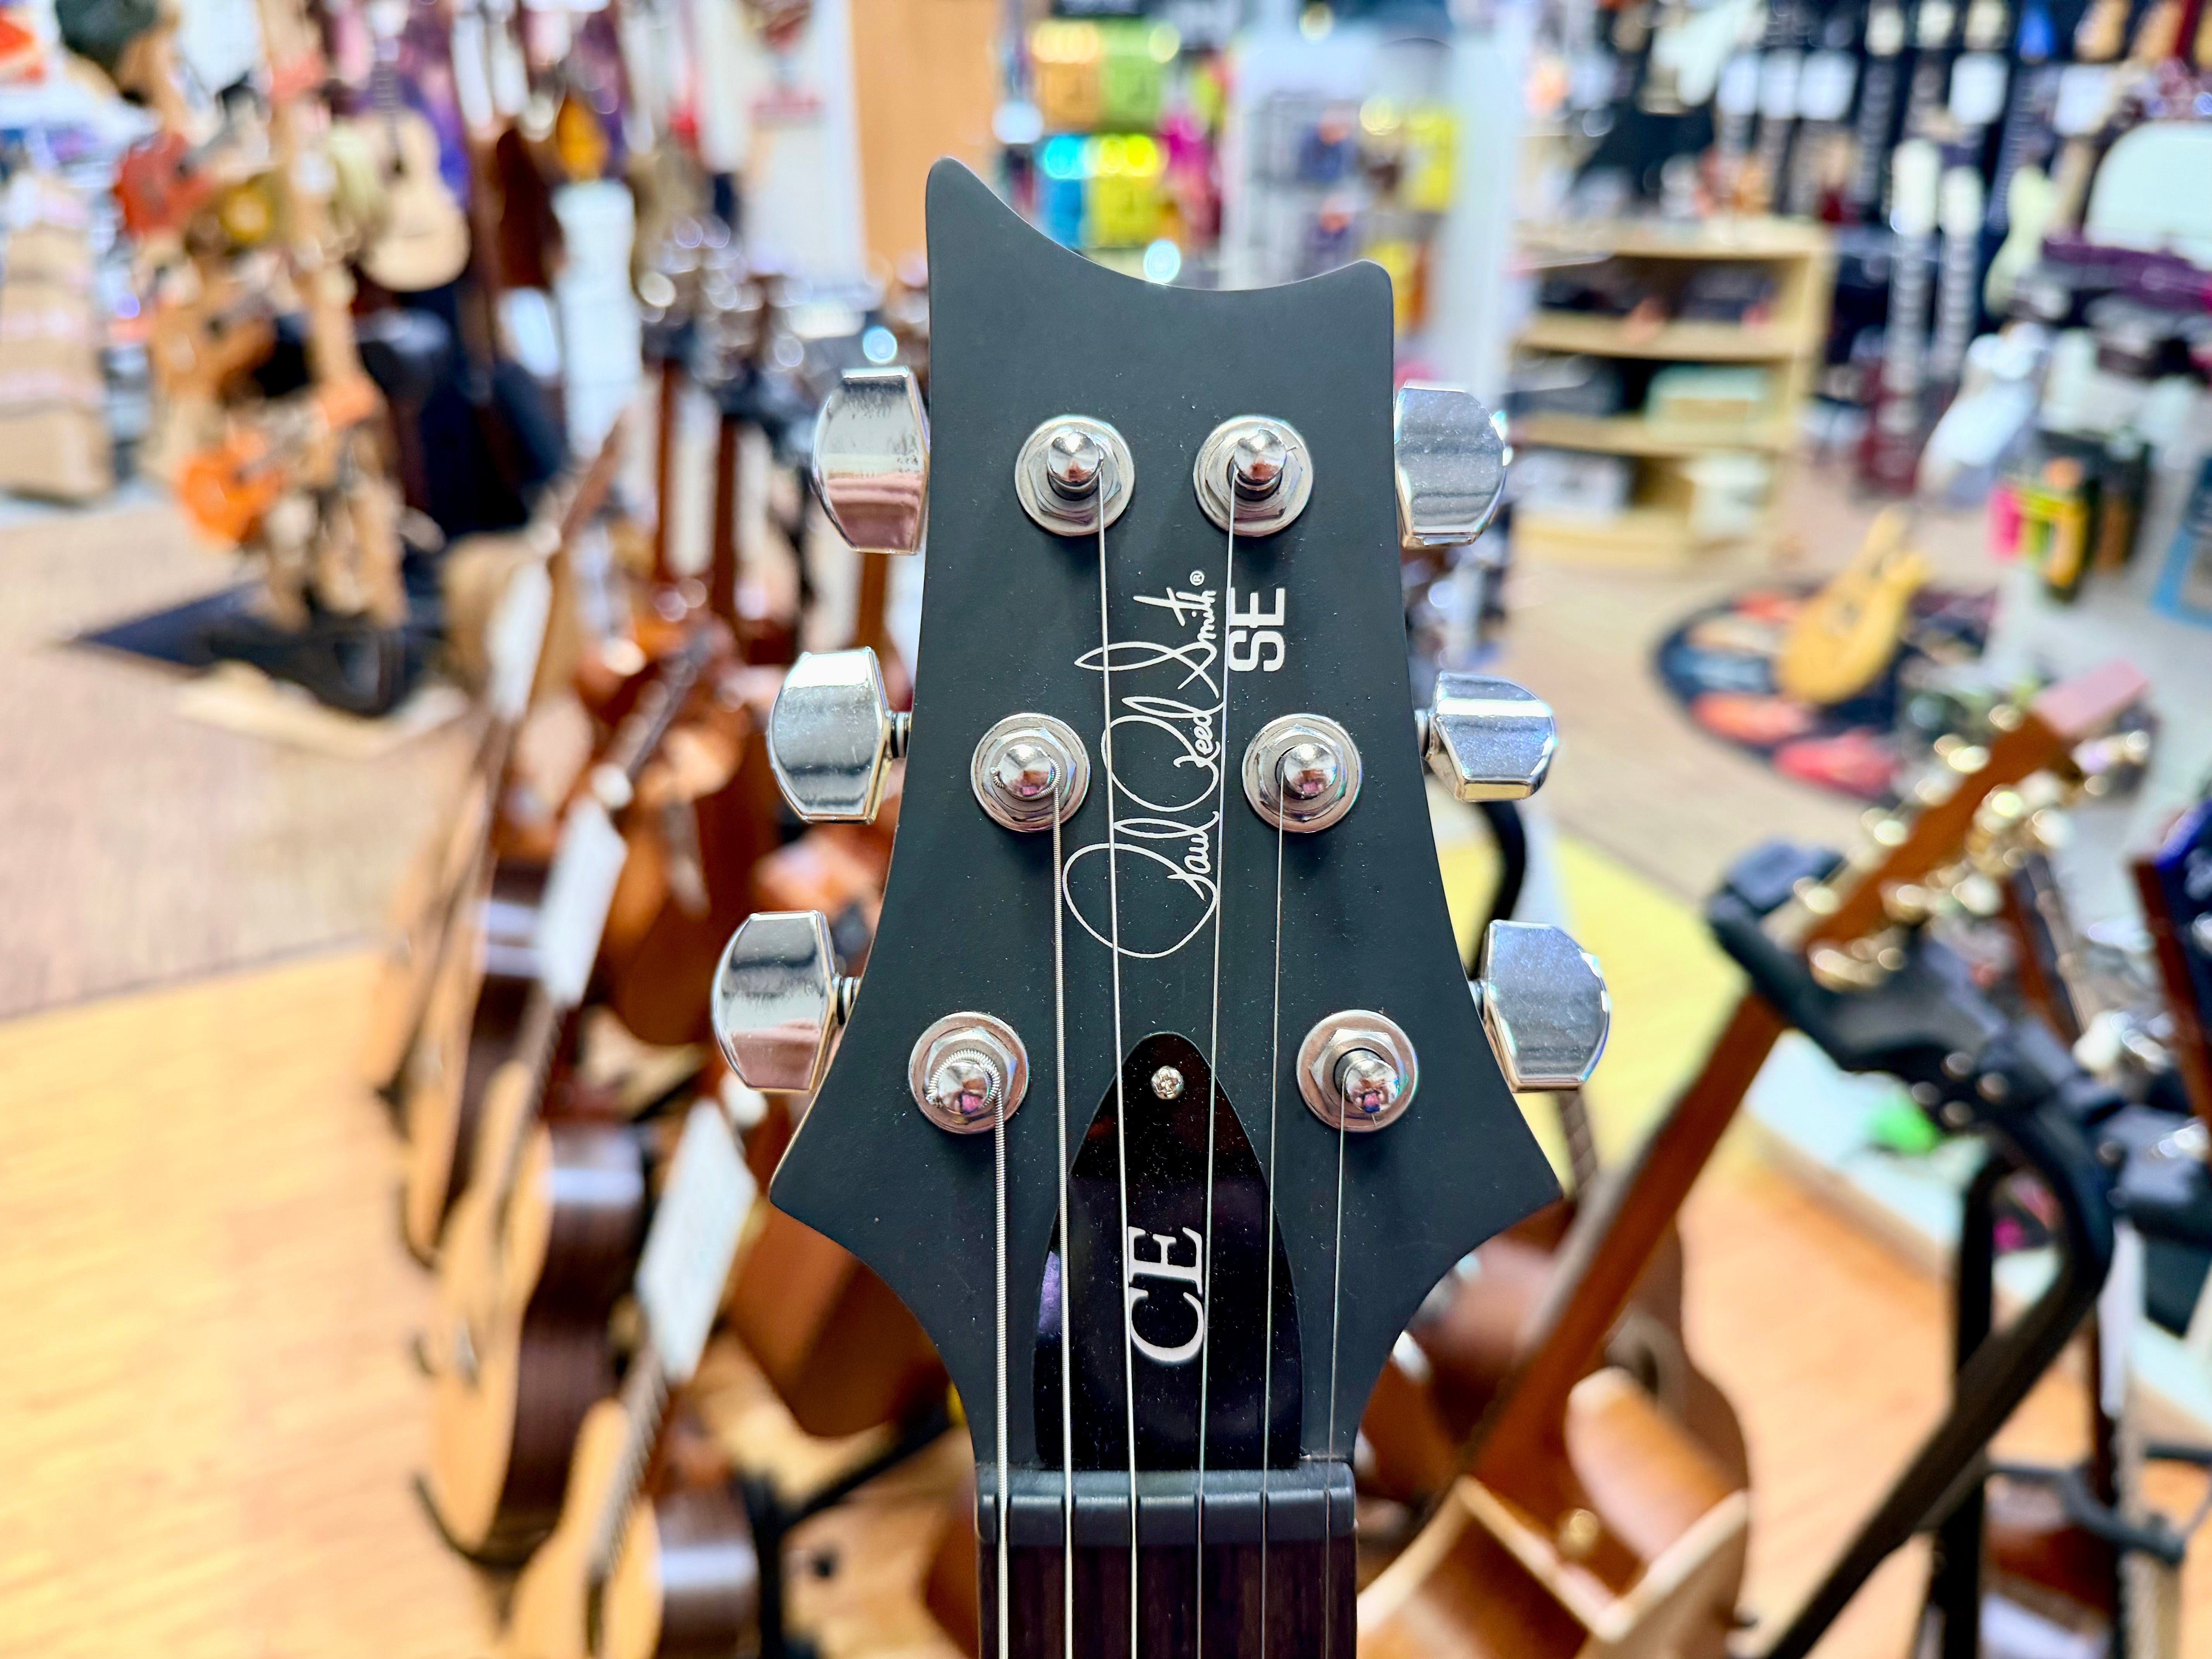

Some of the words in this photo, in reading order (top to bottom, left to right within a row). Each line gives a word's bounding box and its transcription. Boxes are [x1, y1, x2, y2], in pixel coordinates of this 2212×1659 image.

[1228, 587, 1285, 672] SE
[1101, 696, 1223, 812] Reed
[1062, 811, 1219, 958] Paul
[1128, 1226, 1203, 1361] CE
